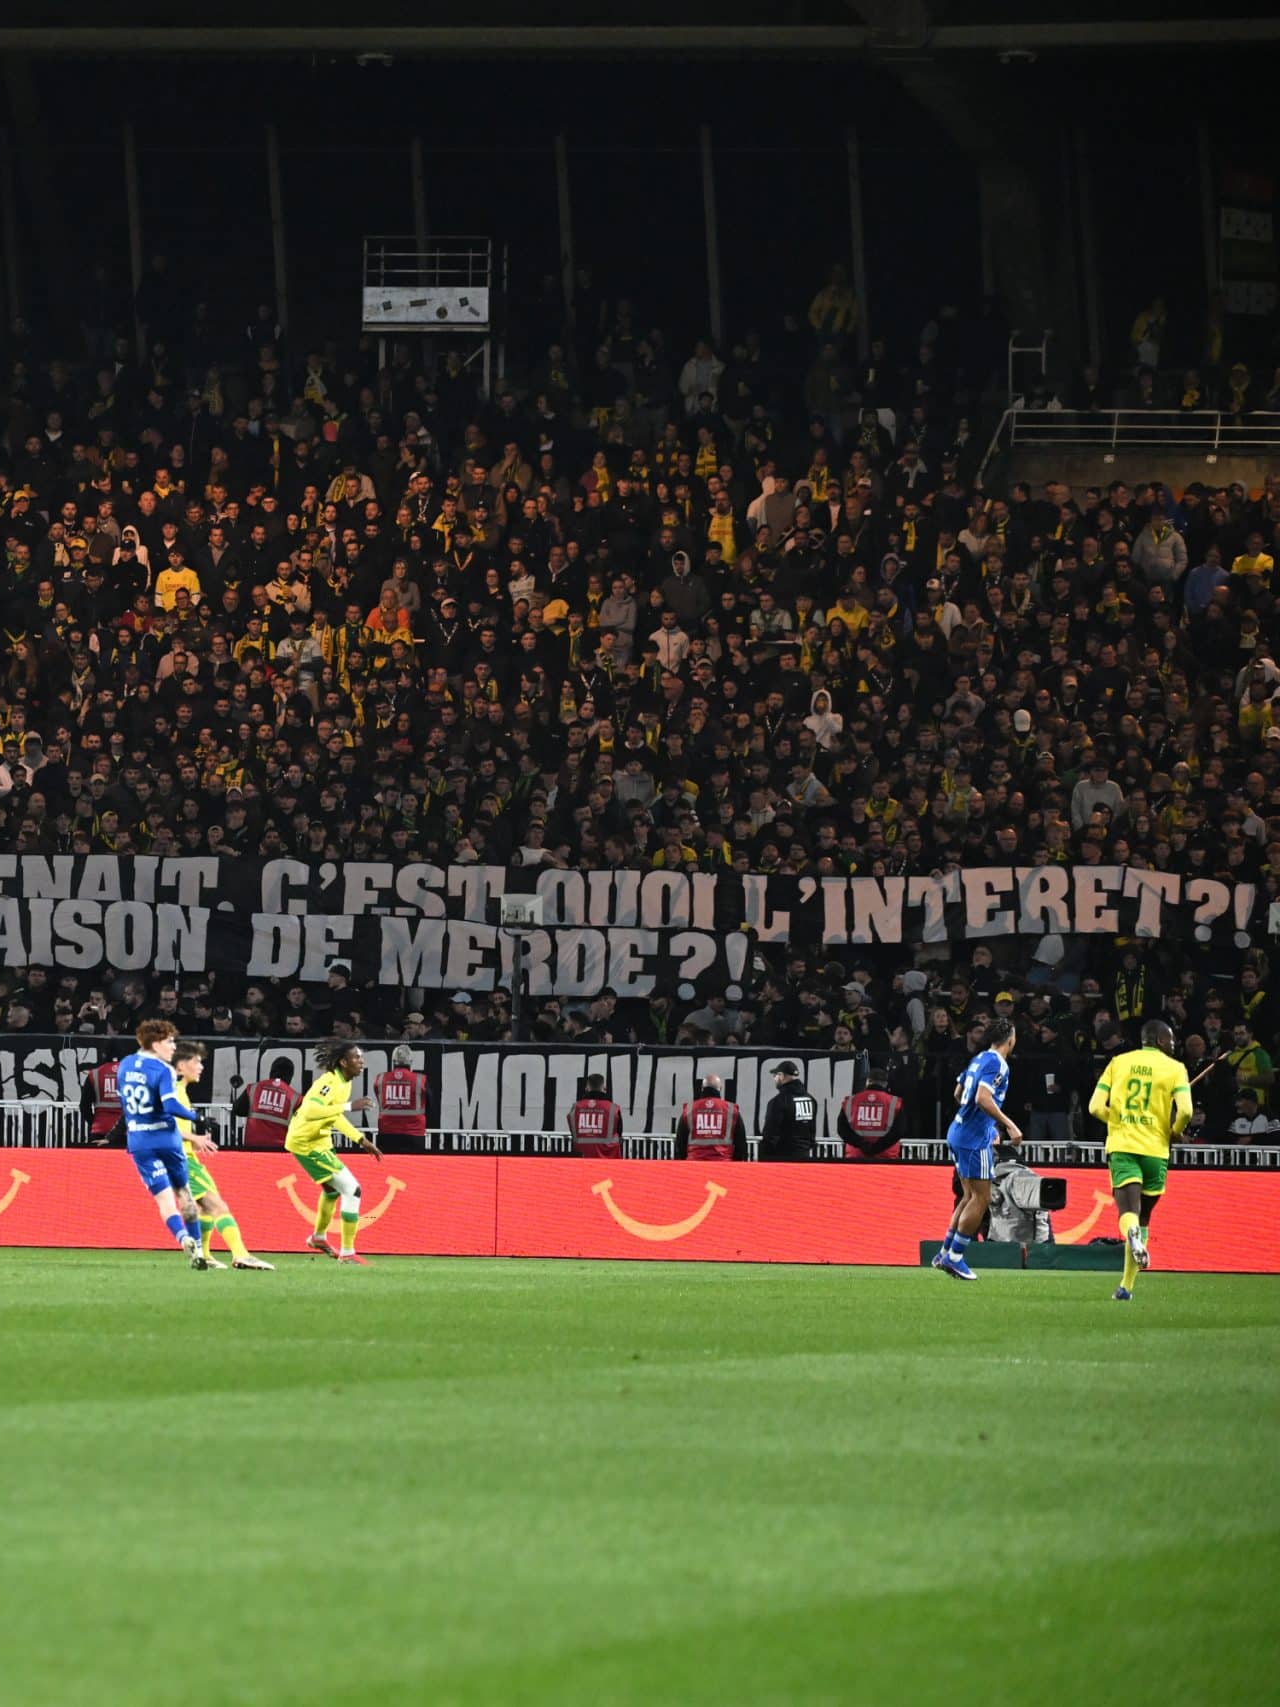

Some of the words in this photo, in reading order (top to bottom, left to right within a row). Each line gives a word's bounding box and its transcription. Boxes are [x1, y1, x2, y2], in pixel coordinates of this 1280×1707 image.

[262, 859, 505, 923] C'EST
[536, 868, 718, 931] QUOI
[247, 912, 354, 981] DE
[123, 1084, 153, 1115] 32
[1125, 1078, 1153, 1112] 21
